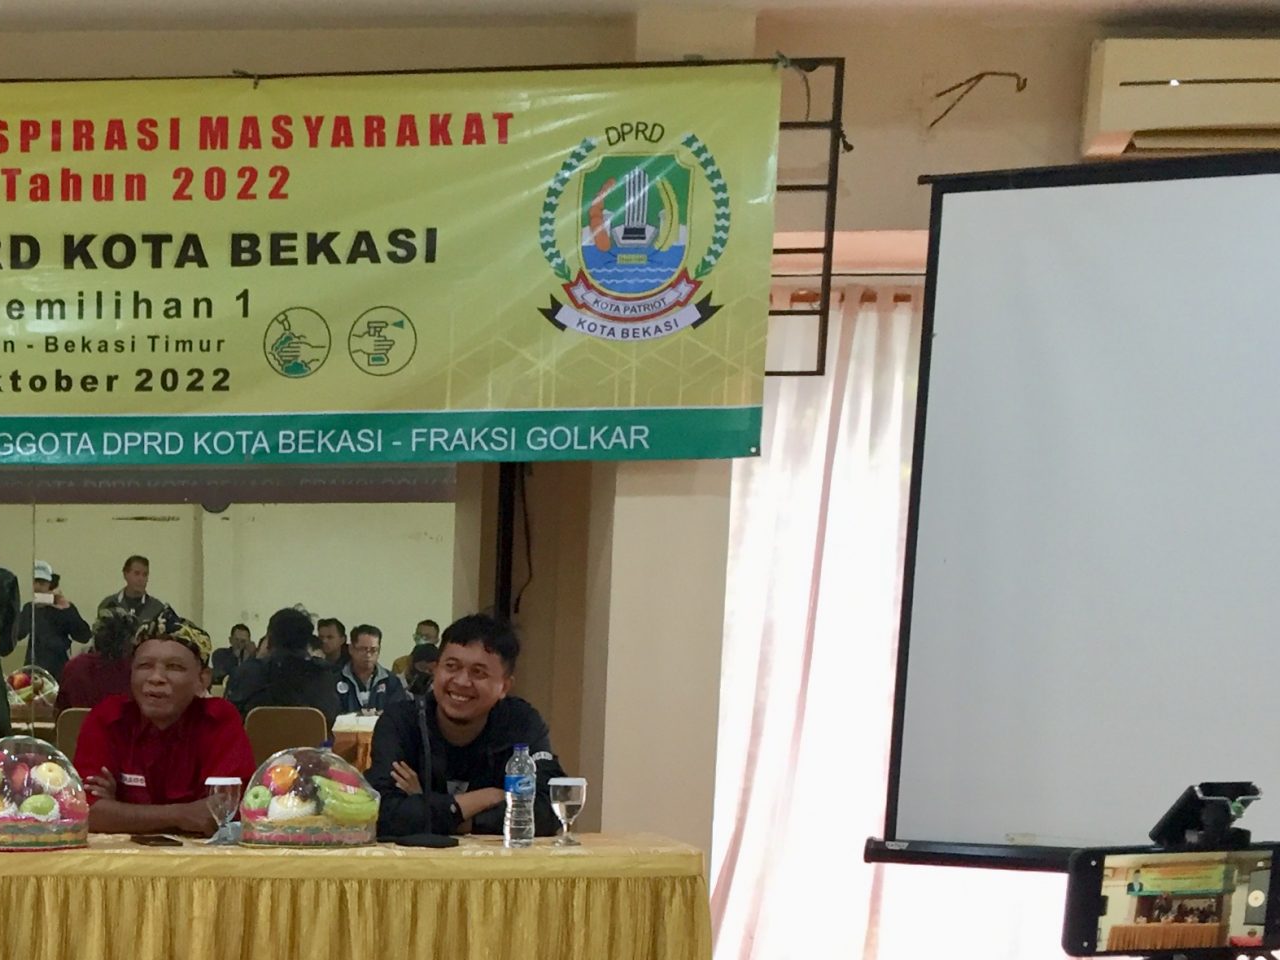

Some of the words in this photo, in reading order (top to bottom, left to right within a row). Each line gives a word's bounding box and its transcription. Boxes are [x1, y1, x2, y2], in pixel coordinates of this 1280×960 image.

[198, 111, 513, 151] MASYARAKAT
[605, 121, 665, 147] DPRD
[0, 167, 147, 202] Tahun
[172, 165, 289, 201] 2022
[63, 232, 209, 270] KOTA
[230, 227, 438, 268] BEKASI
[235, 288, 249, 319] 1
[593, 297, 621, 314] KOTA
[623, 297, 668, 315] PATRIOT
[576, 317, 617, 339] KOTA
[620, 317, 680, 340] BEKASI
[44, 334, 136, 354] Bekasi
[146, 334, 226, 354] Timur
[134, 367, 231, 393] 2022
[103, 432, 184, 455] DPRD
[194, 431, 269, 454] KOTA
[279, 429, 382, 453] BEKASI
[412, 427, 515, 451] FRAKSI
[527, 426, 648, 450] GOLKAR
